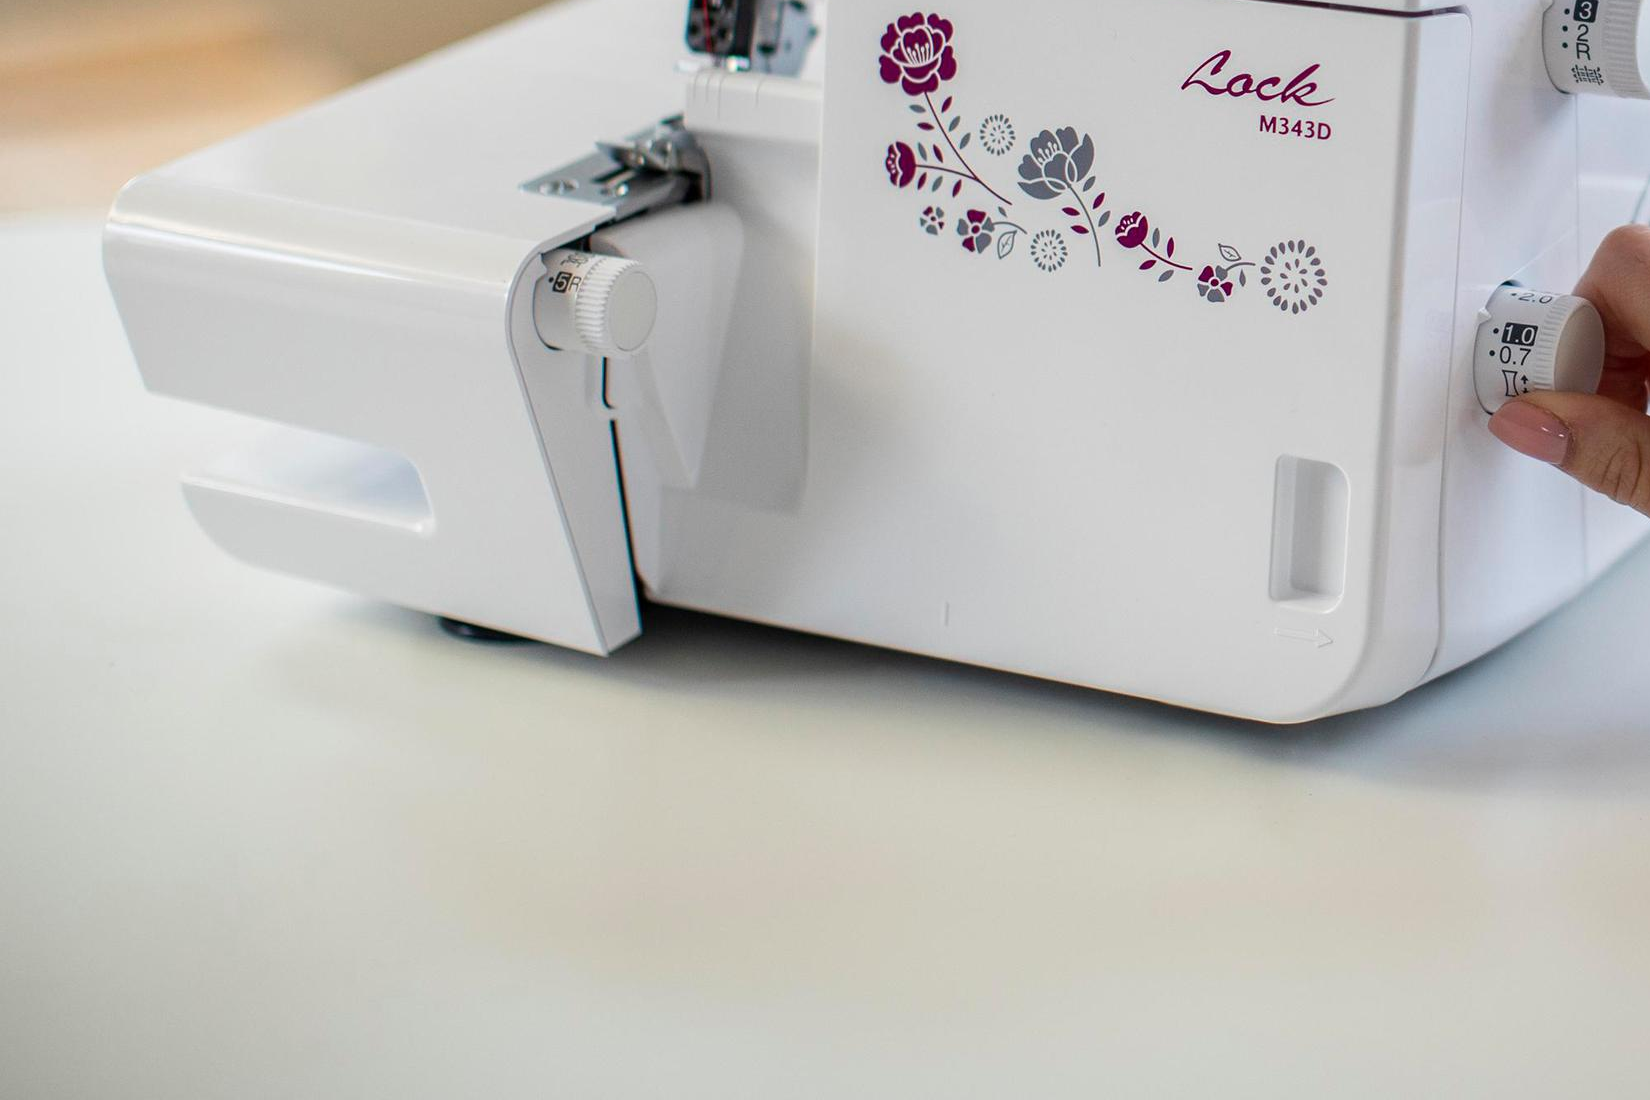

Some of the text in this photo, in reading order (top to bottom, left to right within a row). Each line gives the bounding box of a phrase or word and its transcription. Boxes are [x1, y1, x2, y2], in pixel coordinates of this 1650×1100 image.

[1579, 1, 1592, 20] 3
[1576, 23, 1589, 42] 2
[1576, 42, 1591, 61] R
[1181, 49, 1336, 107] Lock
[1259, 114, 1332, 140] M343D
[1518, 292, 1553, 304] 2.0
[1504, 324, 1536, 345] 1.0
[1500, 345, 1531, 366] 0.7
